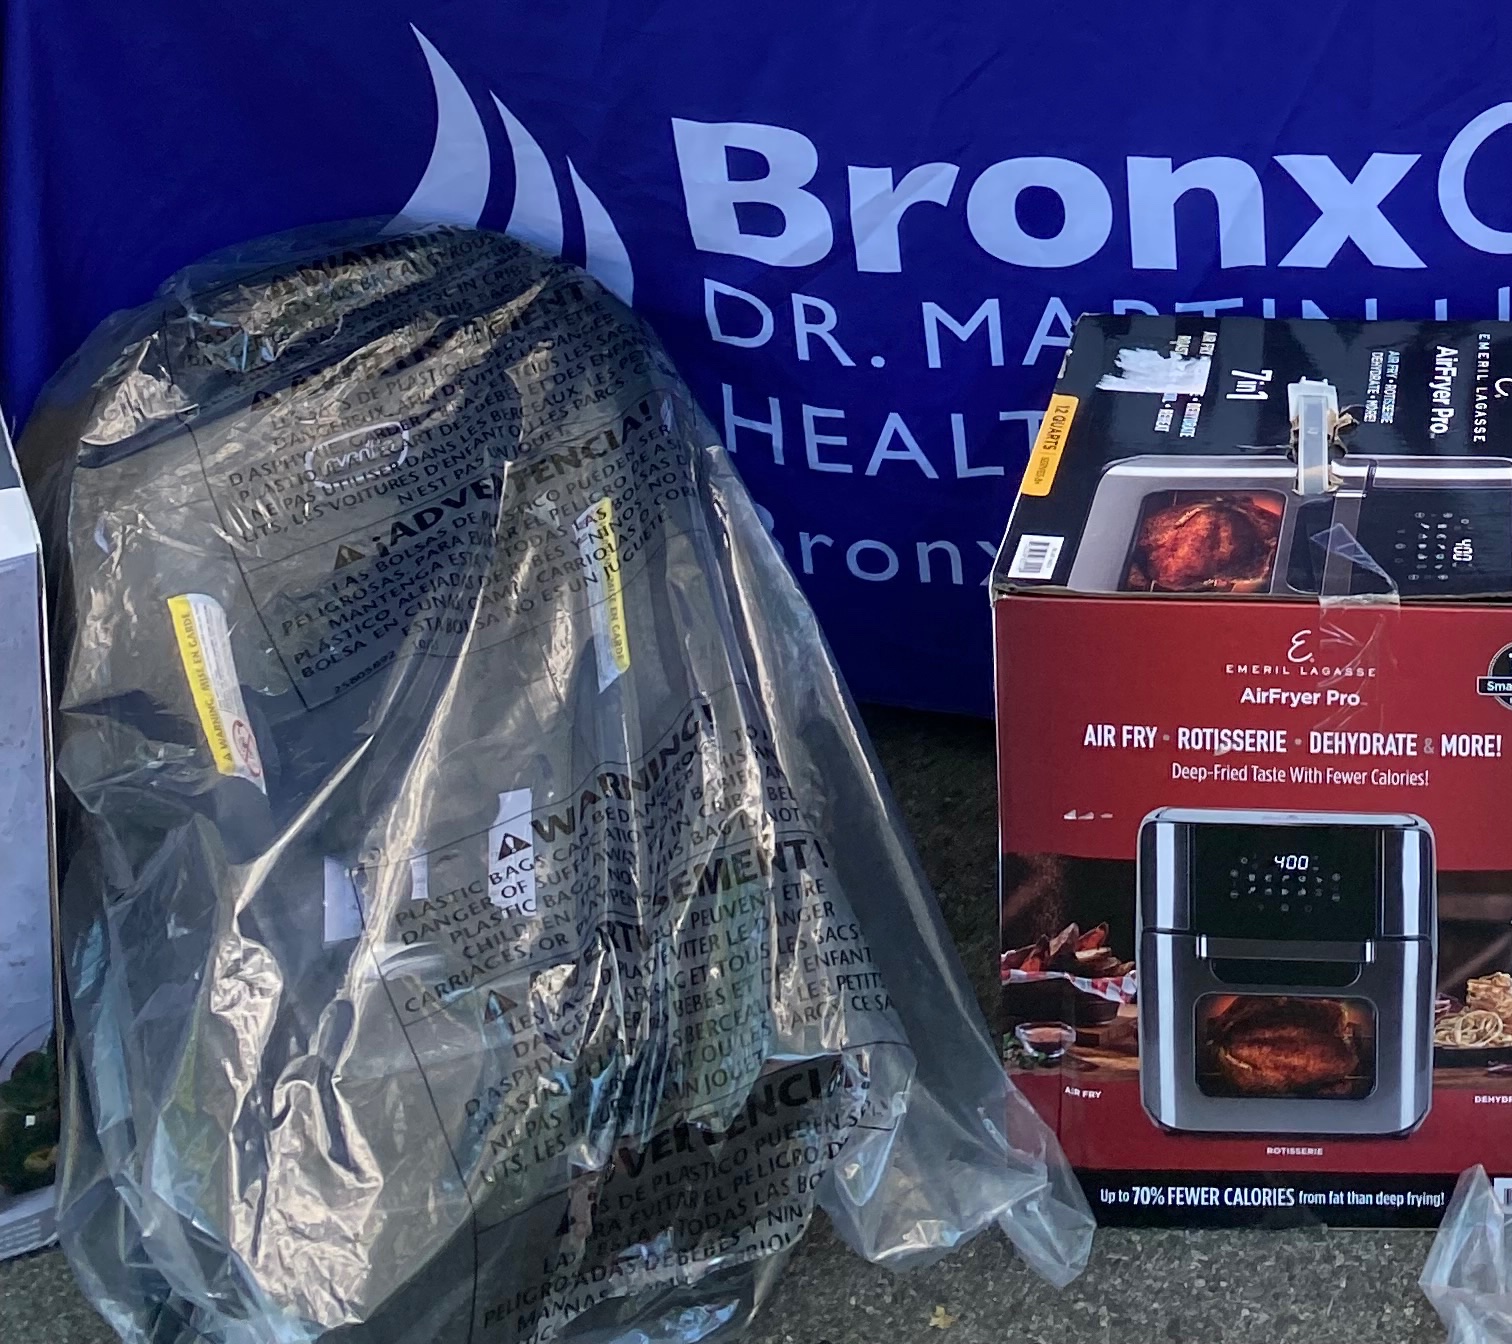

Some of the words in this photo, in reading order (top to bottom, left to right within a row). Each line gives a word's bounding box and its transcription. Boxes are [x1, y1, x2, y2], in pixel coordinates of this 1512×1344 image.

[703, 276, 888, 370] DR.
[1476, 333, 1491, 381] EMERIL
[1429, 345, 1459, 404] AirFryer
[1057, 406, 1070, 419] 12
[1430, 408, 1455, 434] Pro
[1473, 387, 1488, 442] LAGASSE
[720, 382, 1047, 480] HEALT
[1042, 416, 1067, 453] QUARTS
[1226, 663, 1291, 676] EMERIL
[1300, 665, 1377, 678] LAGASSE
[1239, 686, 1321, 708] AirFryer
[1325, 687, 1361, 707] Pro
[1084, 724, 1117, 748] AIR
[1122, 725, 1158, 749] FRY
[1177, 728, 1288, 754] ROTISSERIE
[1308, 731, 1418, 757] DEHYDRATE
[1424, 738, 1435, 754] &
[1440, 734, 1502, 758] MORE!
[1171, 762, 1248, 784] Deep-Fried
[1252, 764, 1287, 784] Taste
[1289, 765, 1323, 785] With
[1325, 767, 1367, 787] Fewer
[1371, 767, 1429, 788] Calories!
[1274, 855, 1309, 871] 400
[1266, 1146, 1323, 1156] ROTISSERIE
[1100, 1188, 1115, 1206] Up
[1117, 1189, 1130, 1204] to
[1132, 1187, 1166, 1206] 70%
[1167, 1187, 1220, 1207] FEWER
[1223, 1188, 1295, 1207] CALORIES
[1298, 1189, 1327, 1206] from
[1329, 1190, 1344, 1206] fat
[1346, 1190, 1373, 1206] than
[1375, 1190, 1404, 1210] deep
[1406, 1191, 1445, 1210] frying!
